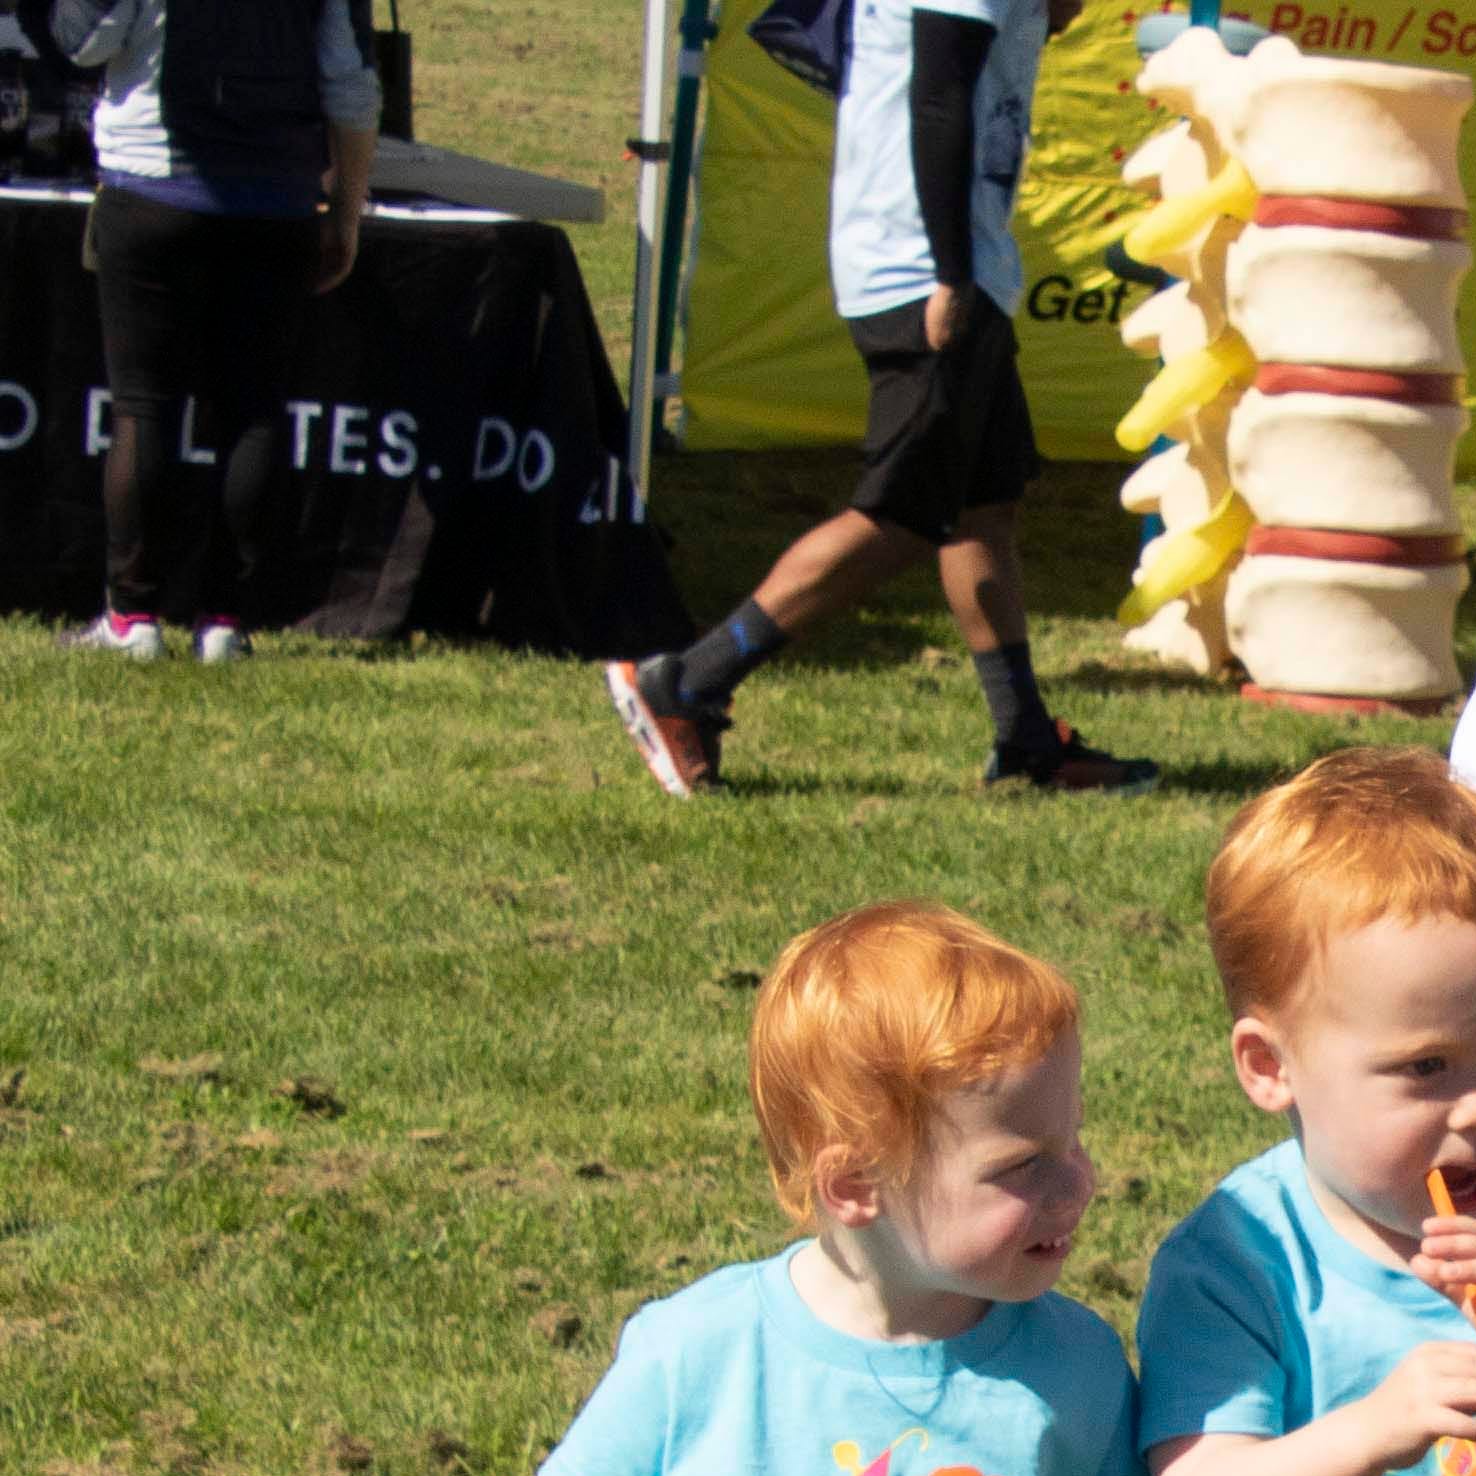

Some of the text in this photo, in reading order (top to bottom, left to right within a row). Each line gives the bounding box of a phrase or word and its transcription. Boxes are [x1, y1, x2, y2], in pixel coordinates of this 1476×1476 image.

[1267, 3, 1377, 53] Pain
[1027, 274, 1131, 324] Get
[473, 415, 555, 493] DO
